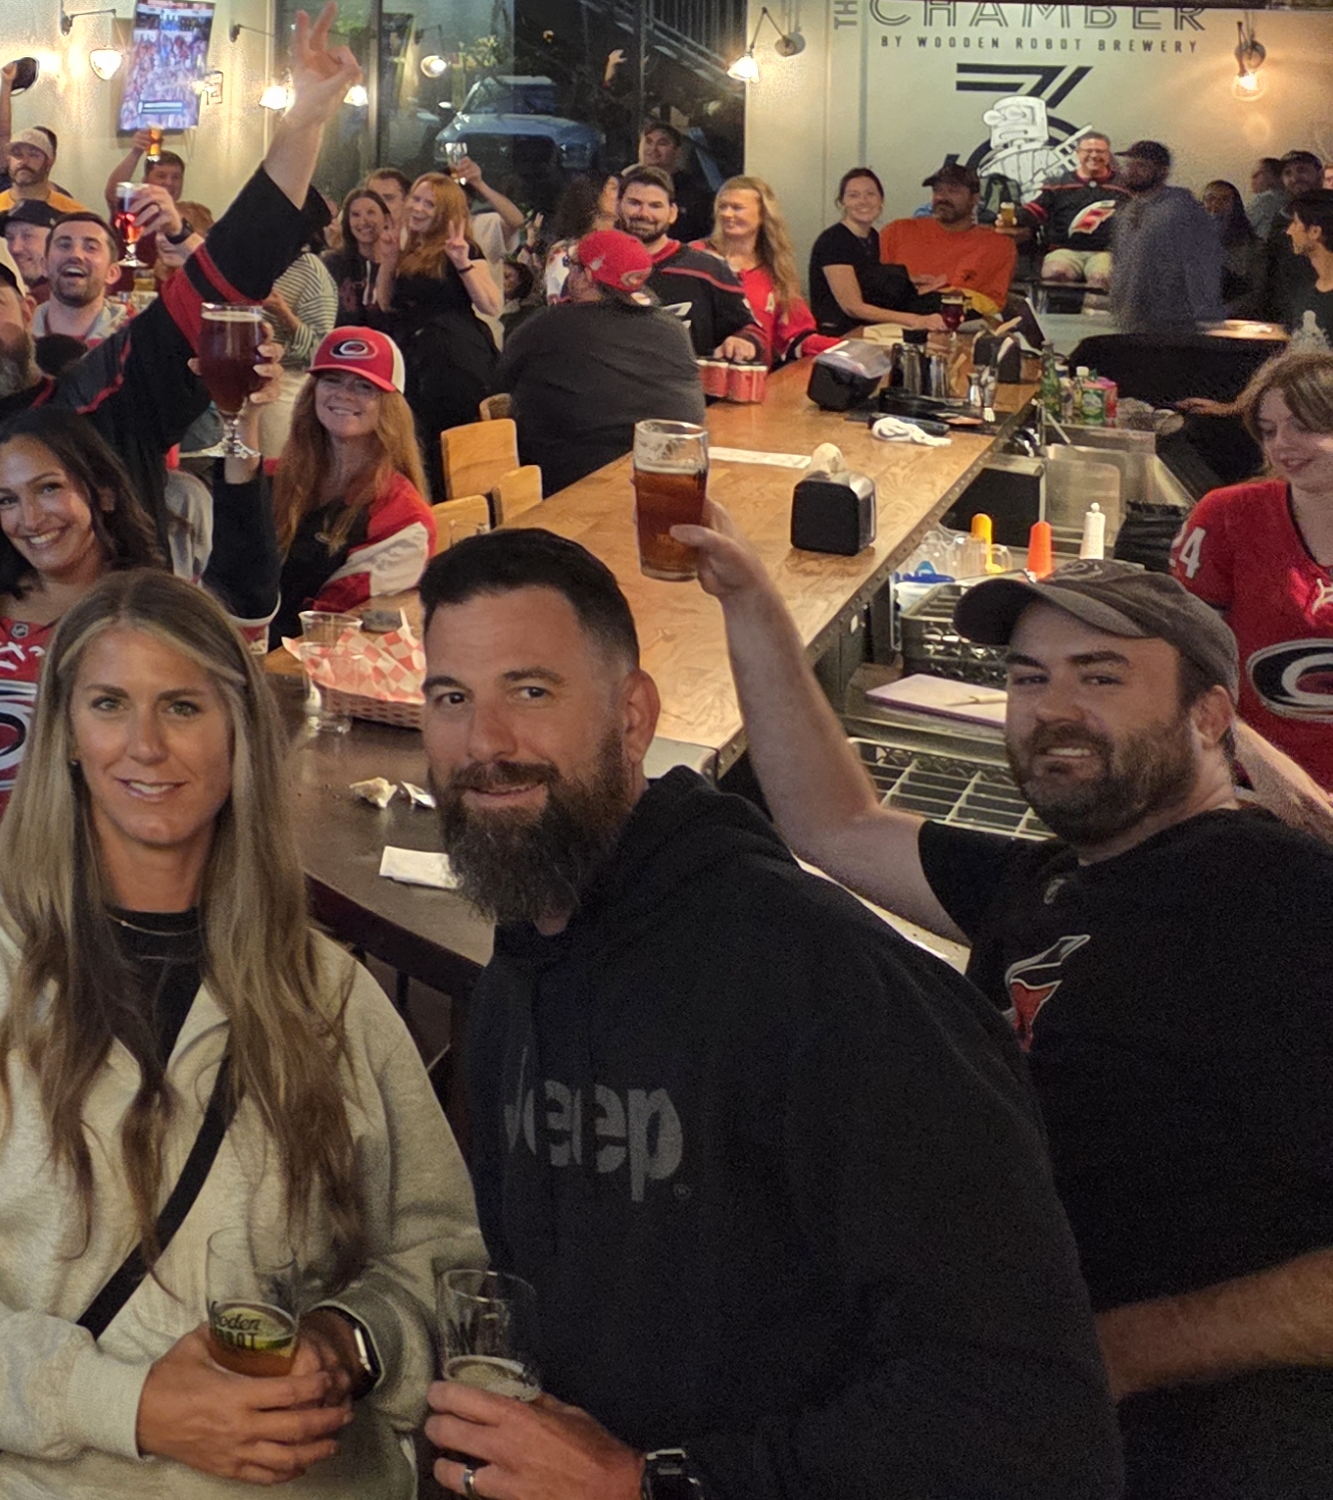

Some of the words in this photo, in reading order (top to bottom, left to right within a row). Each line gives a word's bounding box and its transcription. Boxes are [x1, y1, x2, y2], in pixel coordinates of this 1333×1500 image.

[881, 35, 903, 48] BY
[917, 35, 1000, 49] WOODEN
[1015, 37, 1082, 51] ROBOT
[1098, 38, 1198, 54] BREWERY
